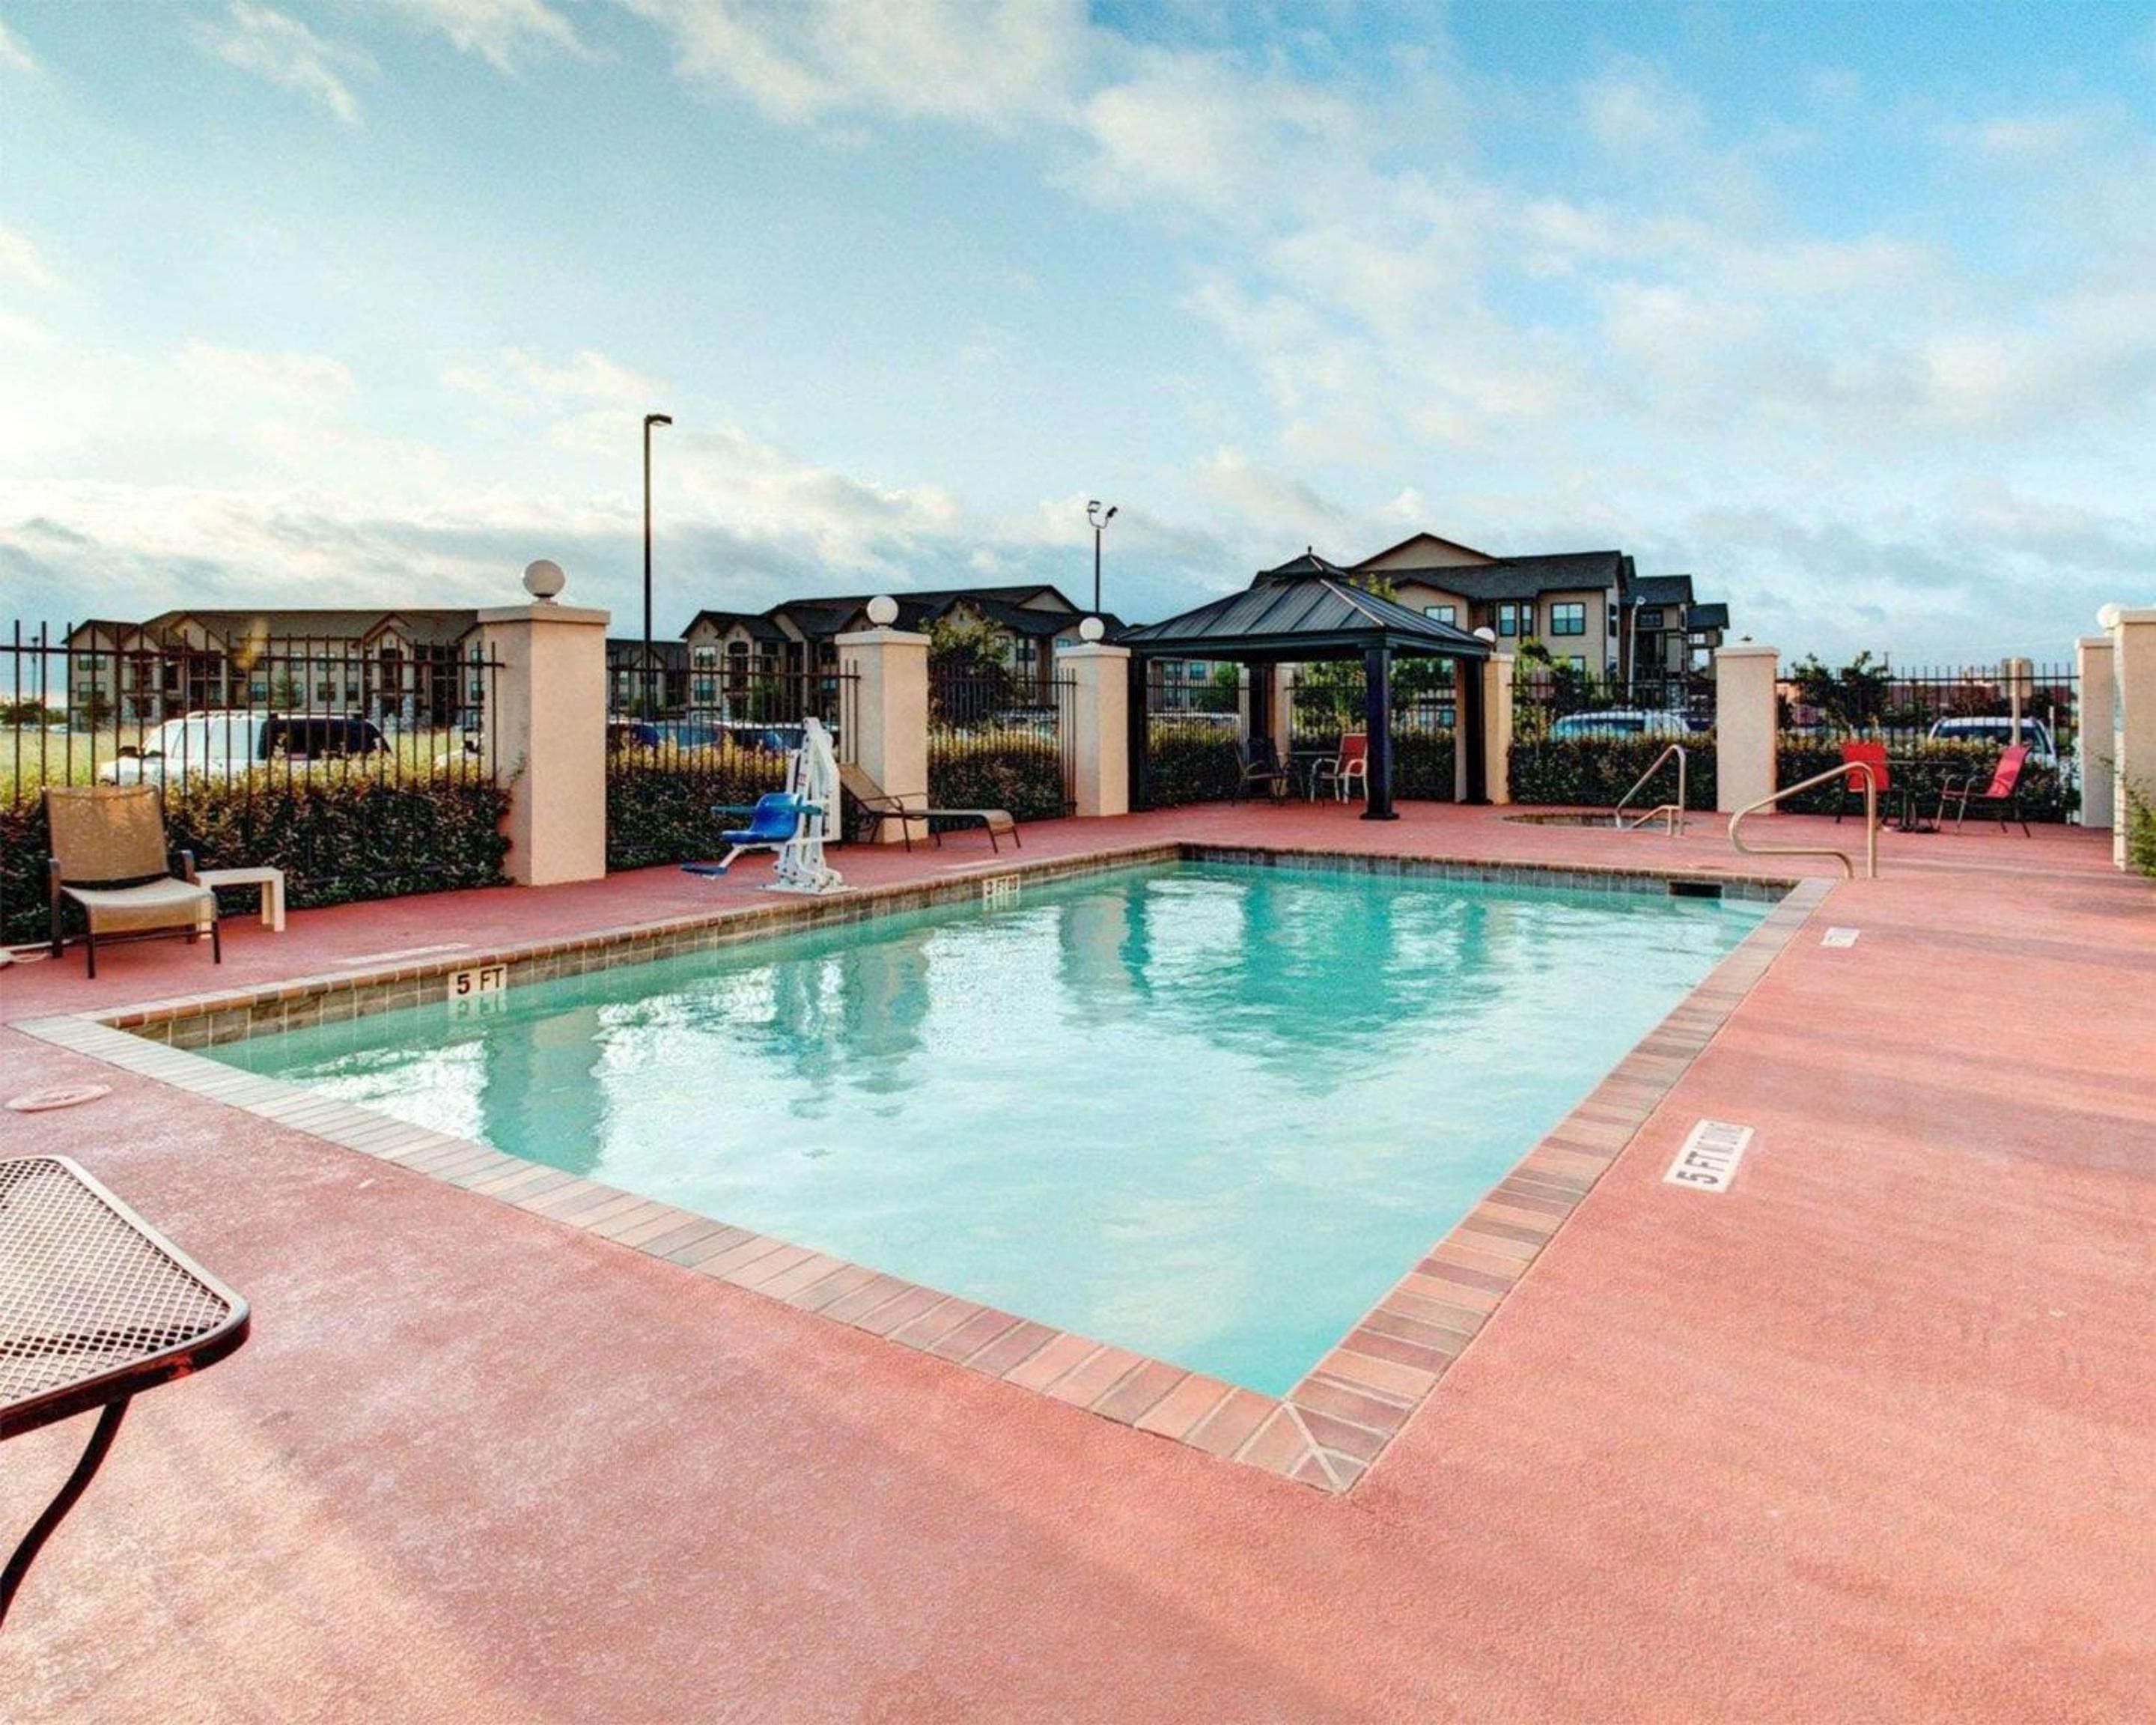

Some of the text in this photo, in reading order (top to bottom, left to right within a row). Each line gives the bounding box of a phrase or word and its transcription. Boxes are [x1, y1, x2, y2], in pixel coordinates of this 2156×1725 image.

[457, 967, 504, 995] 5 FT
[1684, 1151, 1729, 1172] FT
[1675, 1170, 1719, 1184] 5
